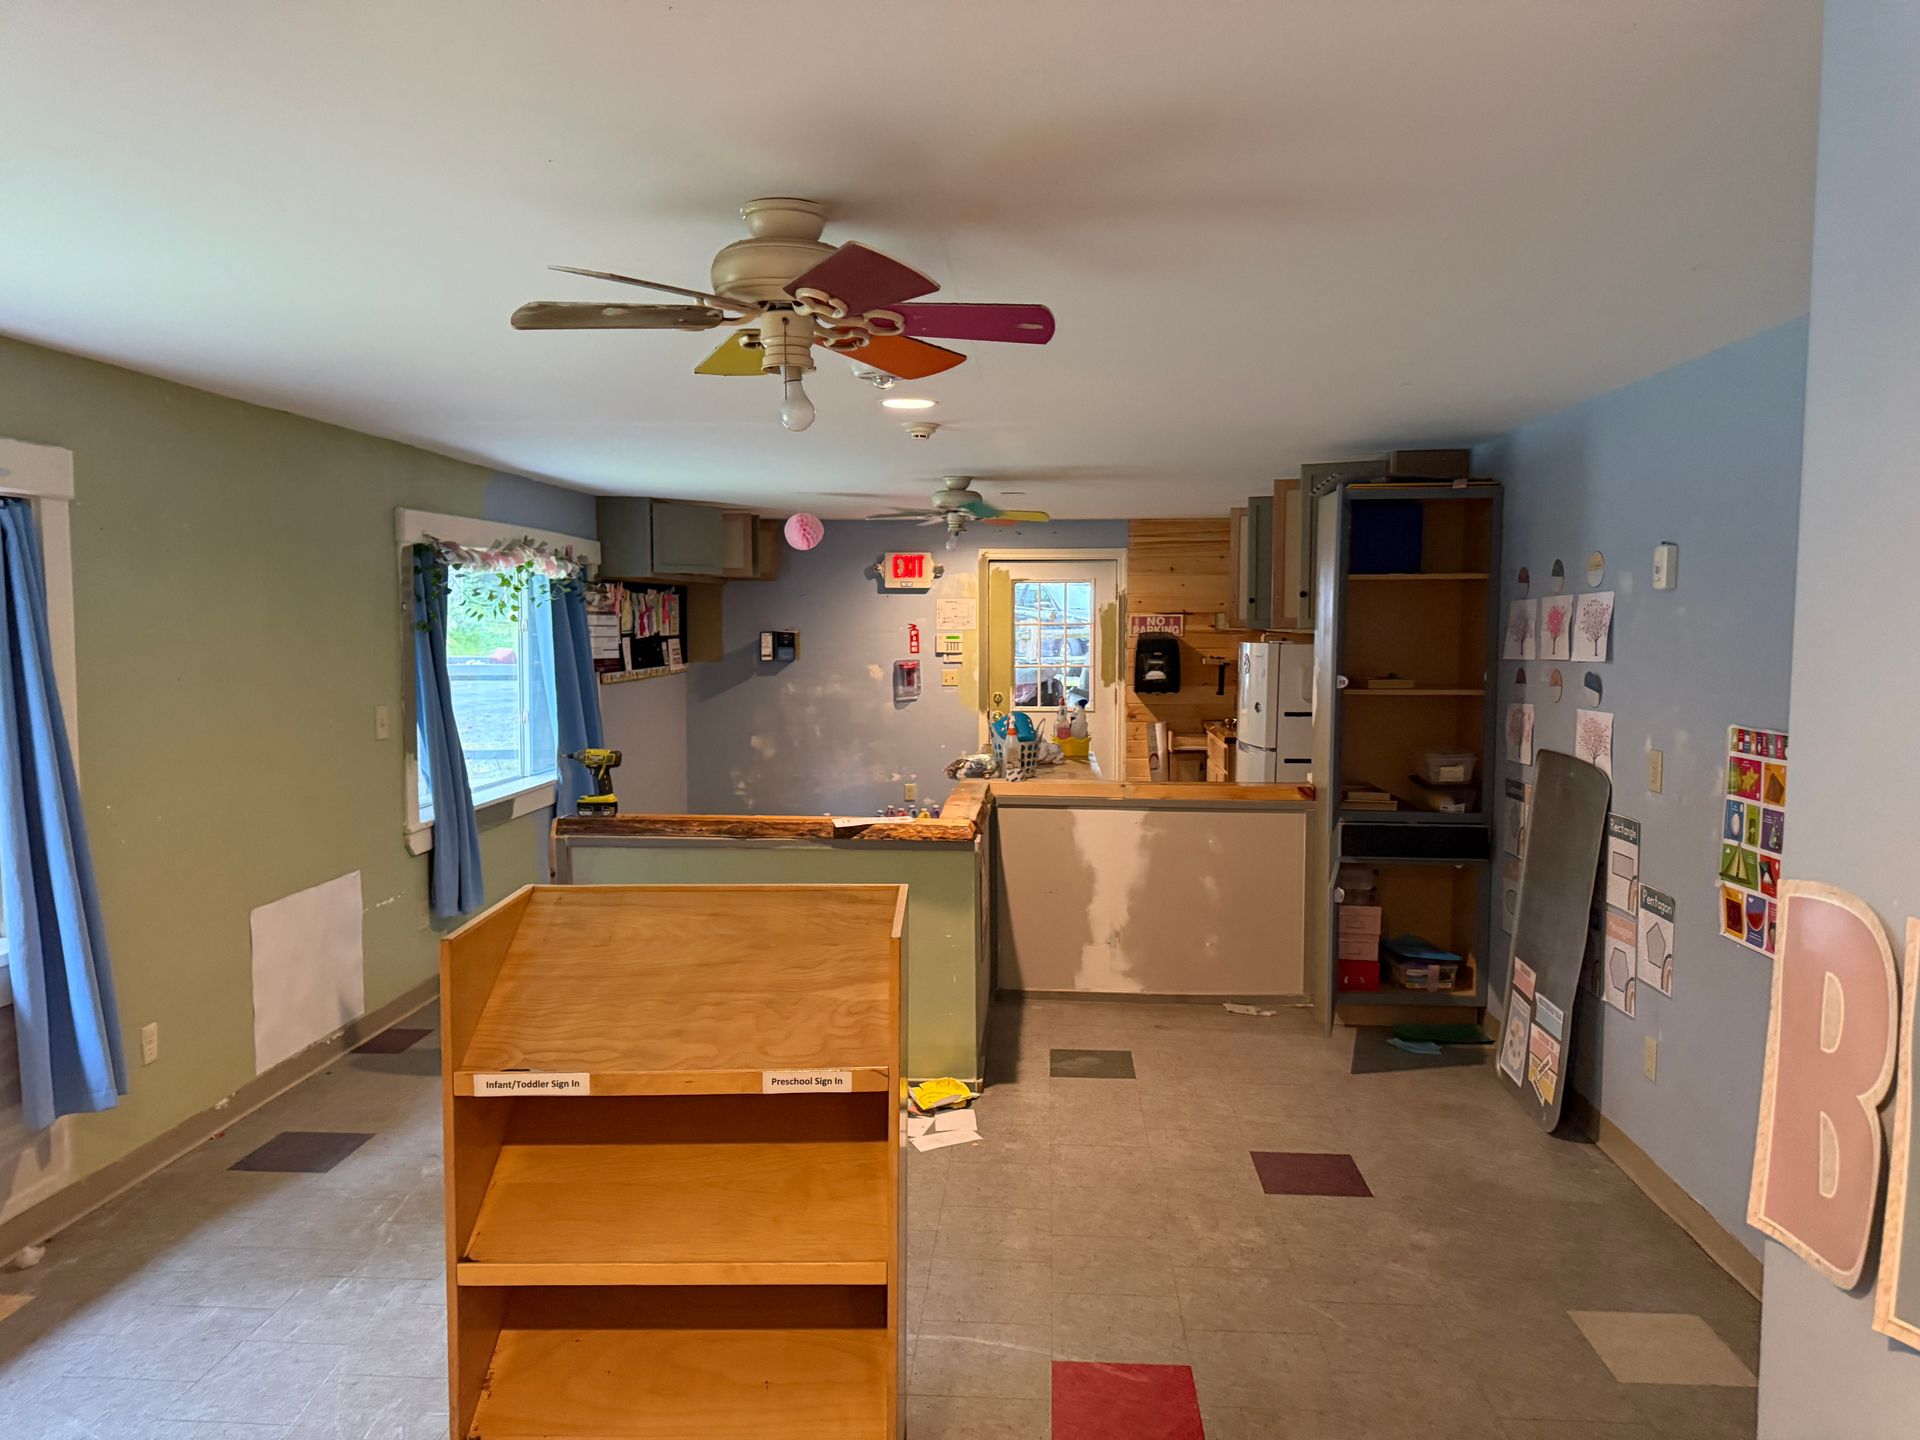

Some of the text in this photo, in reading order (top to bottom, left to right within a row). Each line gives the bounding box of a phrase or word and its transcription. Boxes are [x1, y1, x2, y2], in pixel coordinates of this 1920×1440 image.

[892, 554, 925, 578] EXIT
[1146, 616, 1165, 625] NO
[1133, 626, 1180, 635] PARKING
[1610, 818, 1637, 841] Rectangle
[1642, 888, 1673, 916] Pentagon
[486, 1079, 580, 1089] Infant/Toddler Sign In
[771, 1077, 843, 1086] Preschool Sign In
[1746, 879, 1898, 1291] B
